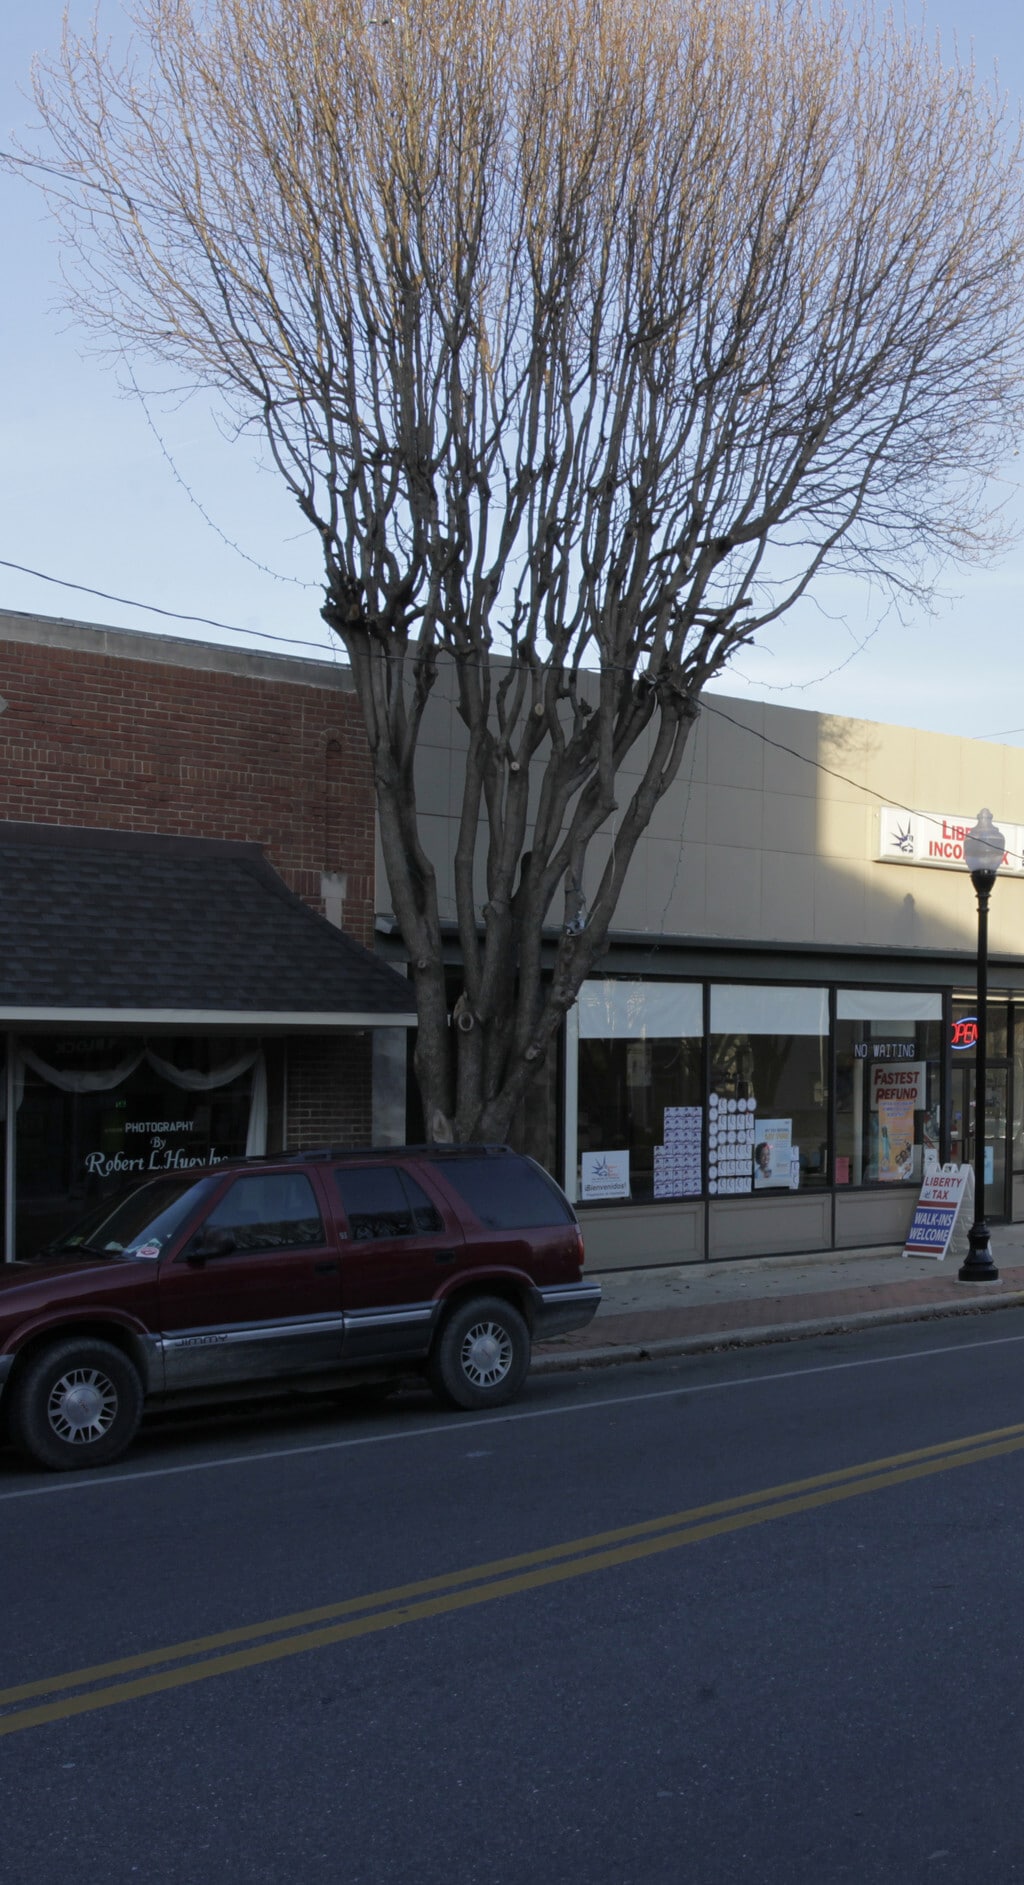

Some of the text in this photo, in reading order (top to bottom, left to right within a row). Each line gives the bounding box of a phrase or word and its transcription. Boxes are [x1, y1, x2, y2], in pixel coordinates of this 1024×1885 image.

[854, 1043, 915, 1058] NO WAITING
[874, 1068, 920, 1085] FASTEST
[875, 1087, 918, 1103] REFUND
[125, 1121, 194, 1133] PHOTOGRAPHY
[149, 1136, 167, 1150] By
[85, 1151, 144, 1177] Robert
[925, 1176, 963, 1188] LIBERTY
[932, 1189, 949, 1200] TAX
[914, 1212, 953, 1226] WALK-INS
[909, 1227, 950, 1241] WELCOME
